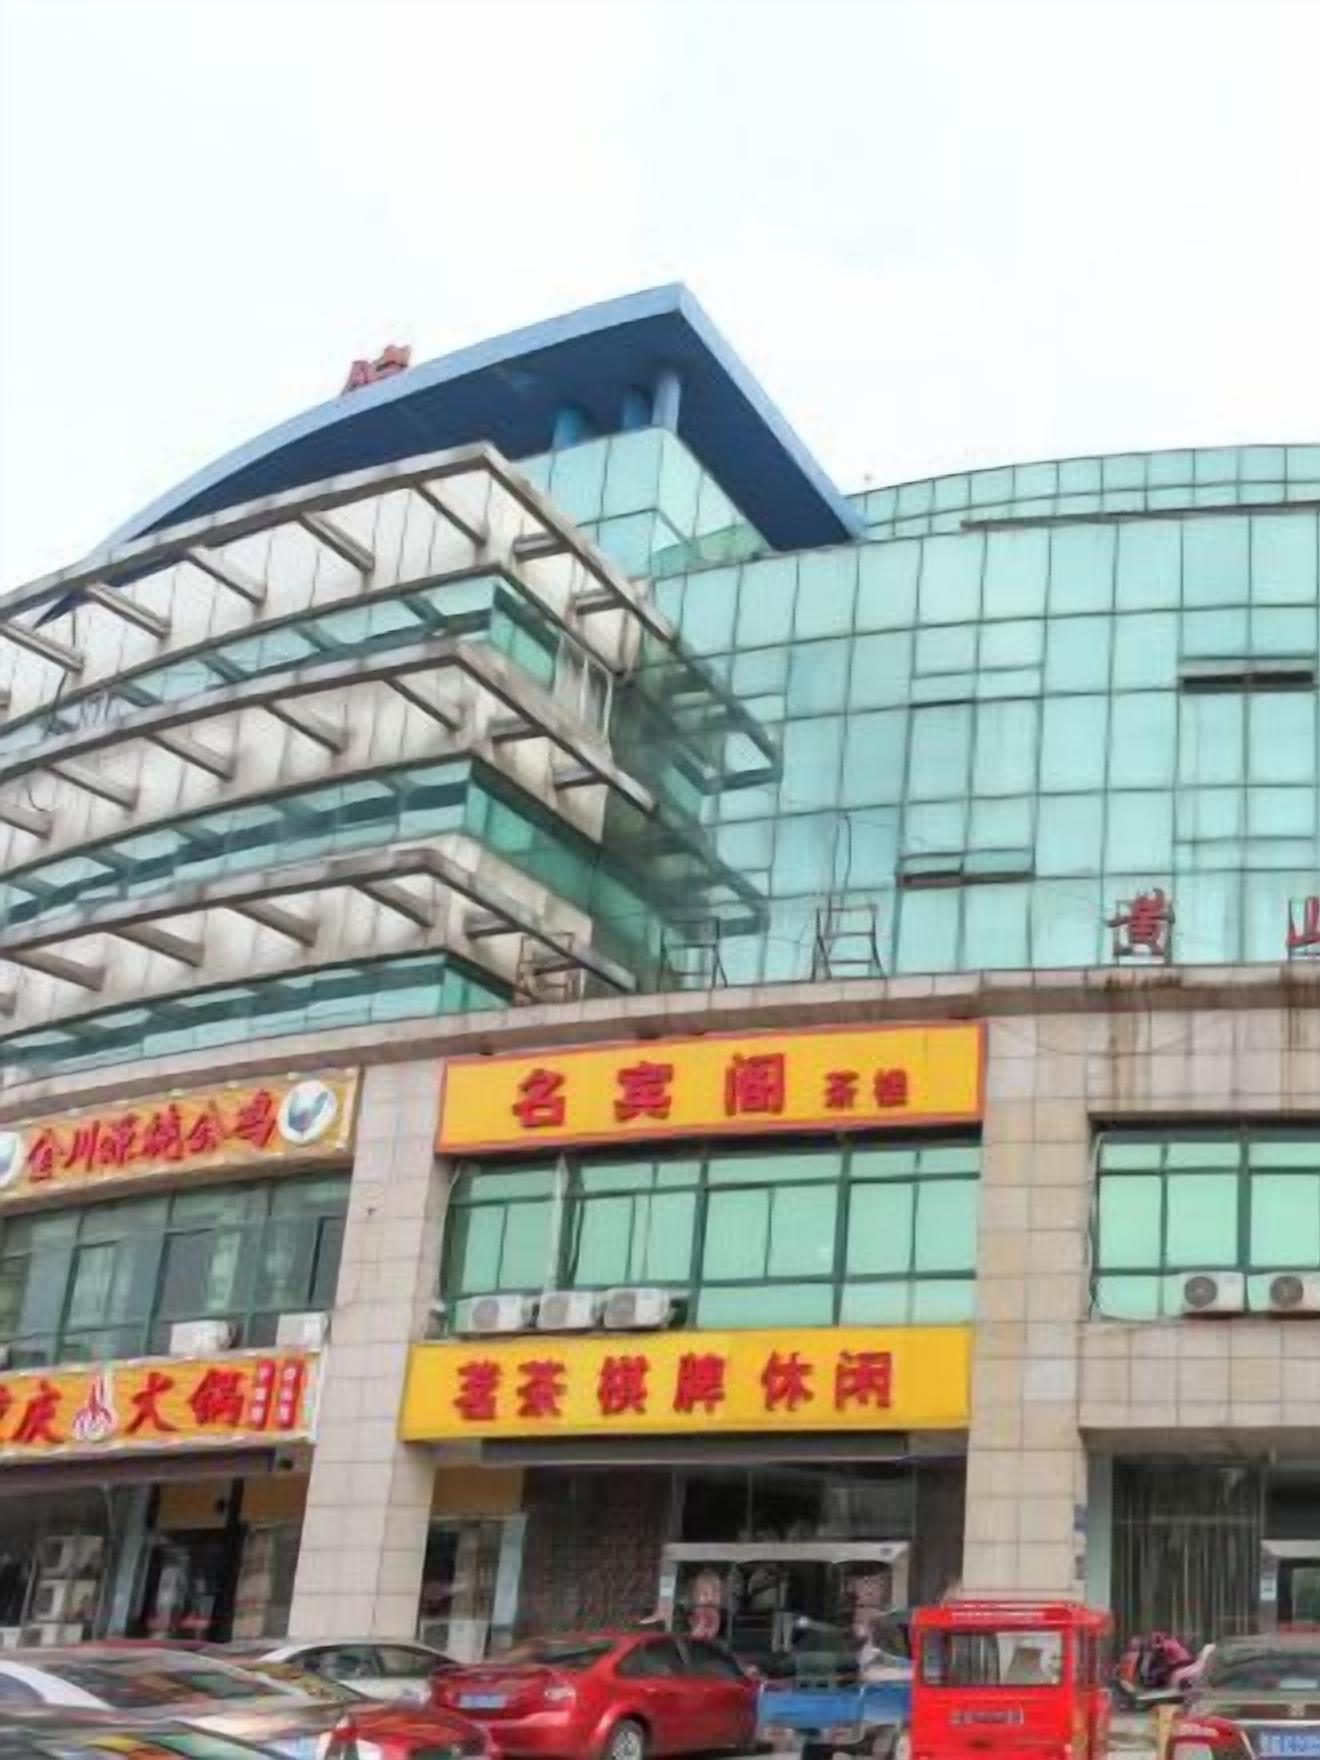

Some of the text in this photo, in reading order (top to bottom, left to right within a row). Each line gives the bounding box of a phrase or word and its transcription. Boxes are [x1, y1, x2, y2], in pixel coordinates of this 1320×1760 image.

[512, 1052, 786, 1129] 名宾阁
[453, 1349, 894, 1421] 茗茶棋牌休闲
